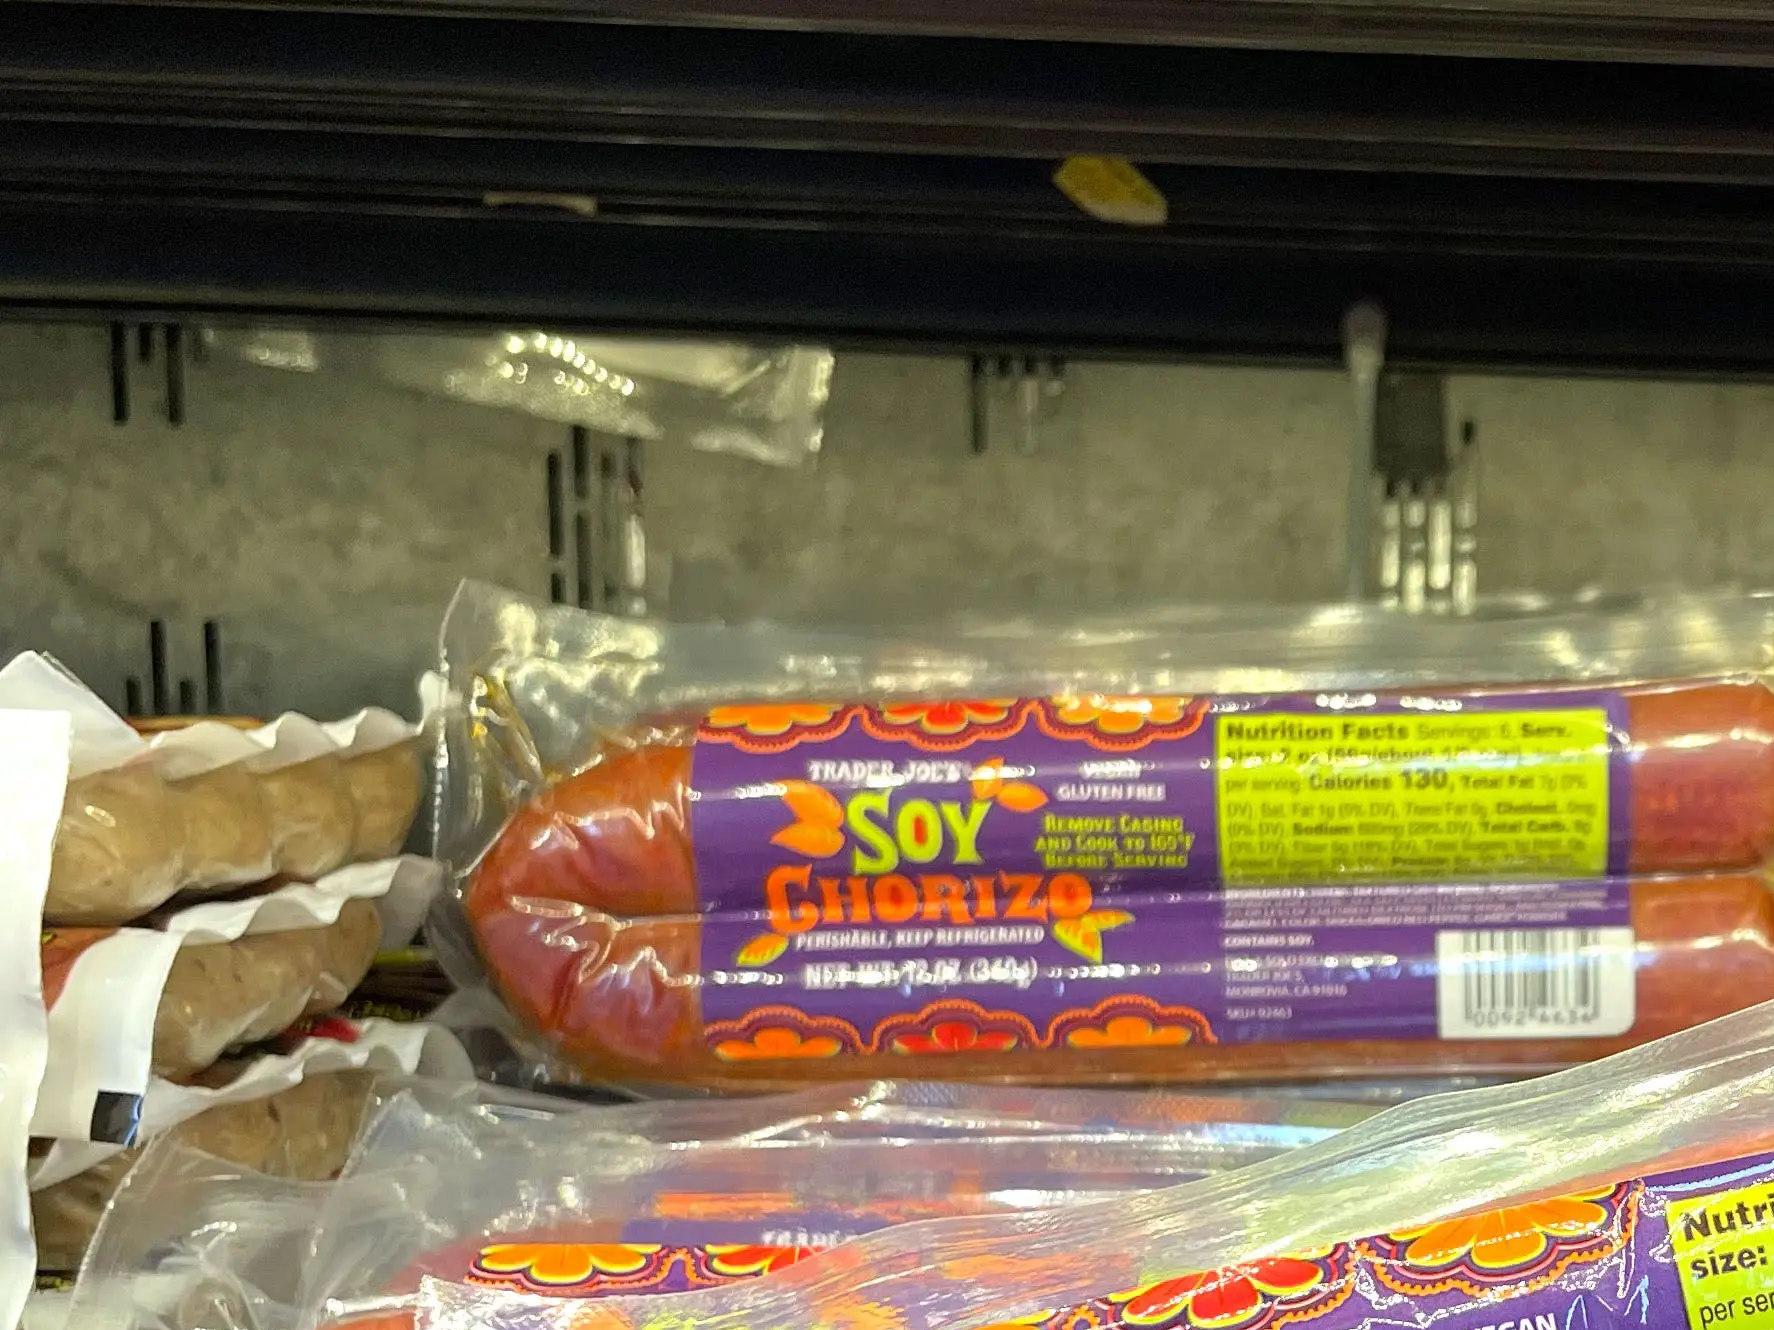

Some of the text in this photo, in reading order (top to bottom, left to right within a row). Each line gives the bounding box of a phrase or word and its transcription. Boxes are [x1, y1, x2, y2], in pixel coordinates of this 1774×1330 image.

[1058, 784, 1166, 802] GLUTEN FREE
[846, 788, 992, 876] SOY
[1045, 814, 1114, 834] REMOVE
[765, 864, 1093, 935] CHORIZO
[1691, 1246, 1766, 1278] size:
[1699, 1299, 1735, 1330] per
